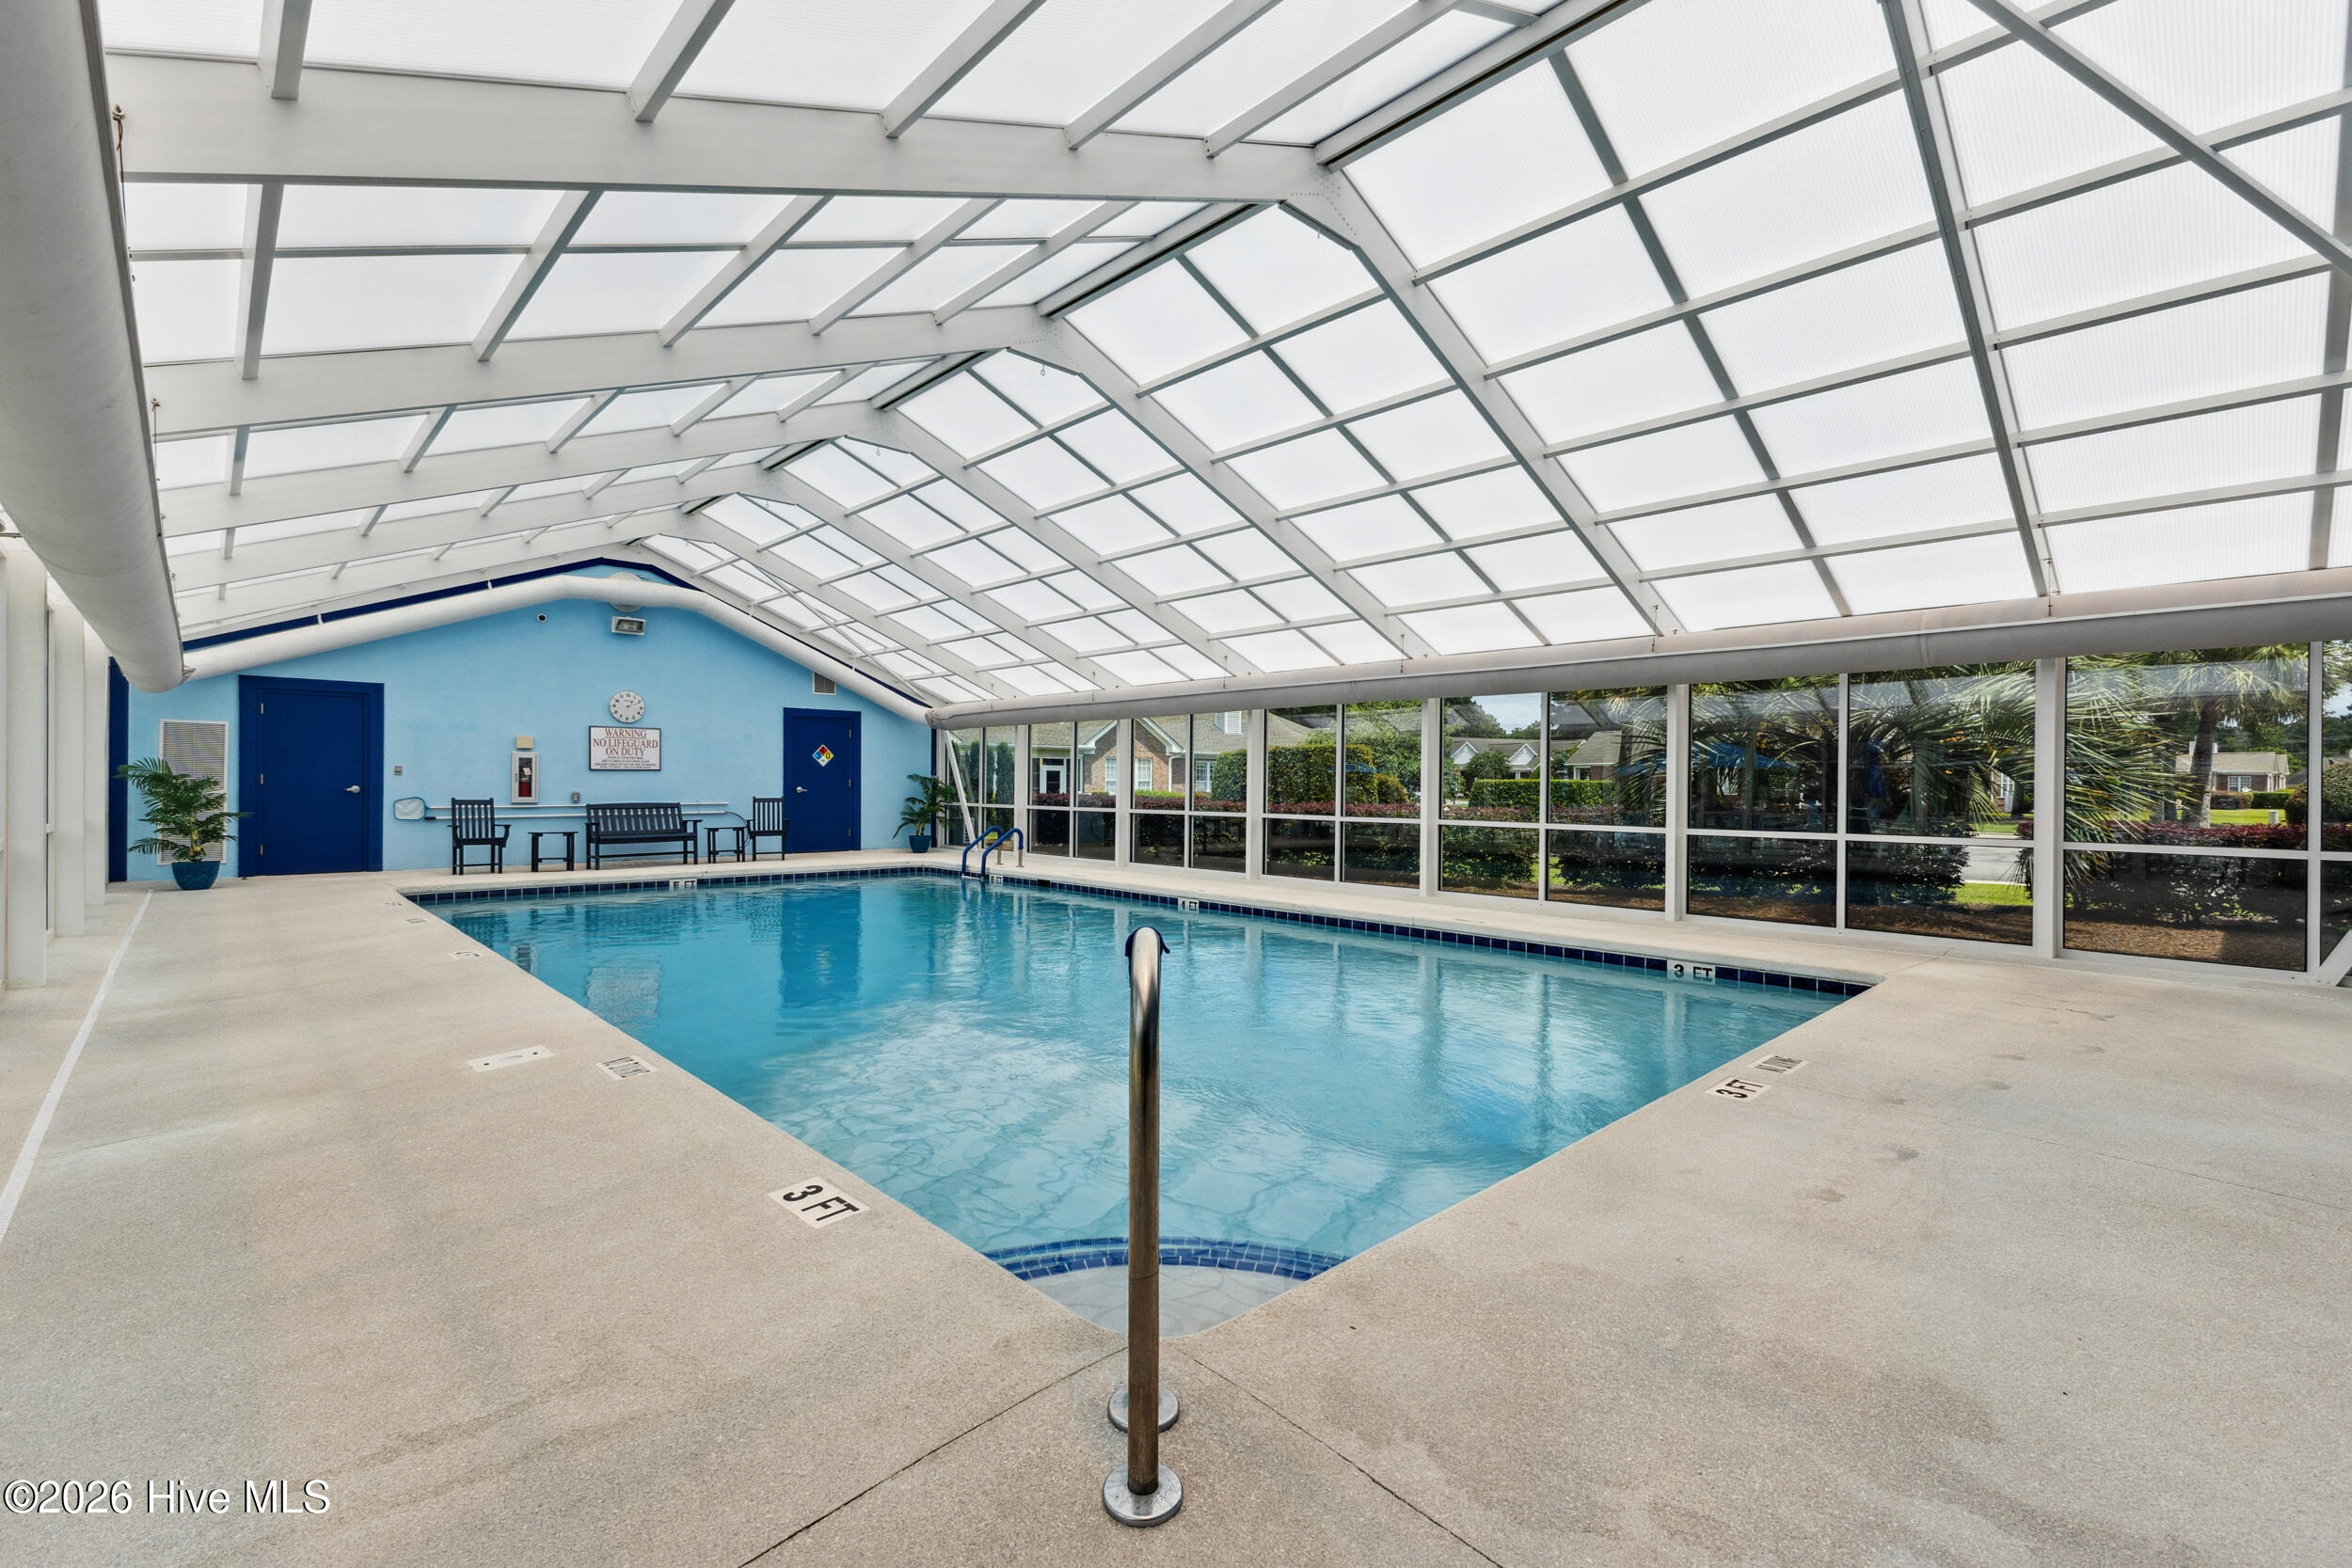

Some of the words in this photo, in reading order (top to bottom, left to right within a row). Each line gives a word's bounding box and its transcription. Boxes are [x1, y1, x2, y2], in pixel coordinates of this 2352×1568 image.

[604, 729, 647, 737] WARNING
[593, 738, 606, 747] NO
[609, 739, 658, 748] LIFEGUARD
[1724, 1079, 1764, 1092] FT
[1716, 1089, 1748, 1098] 3
[783, 1185, 823, 1202] 3
[801, 1196, 860, 1221] FT
